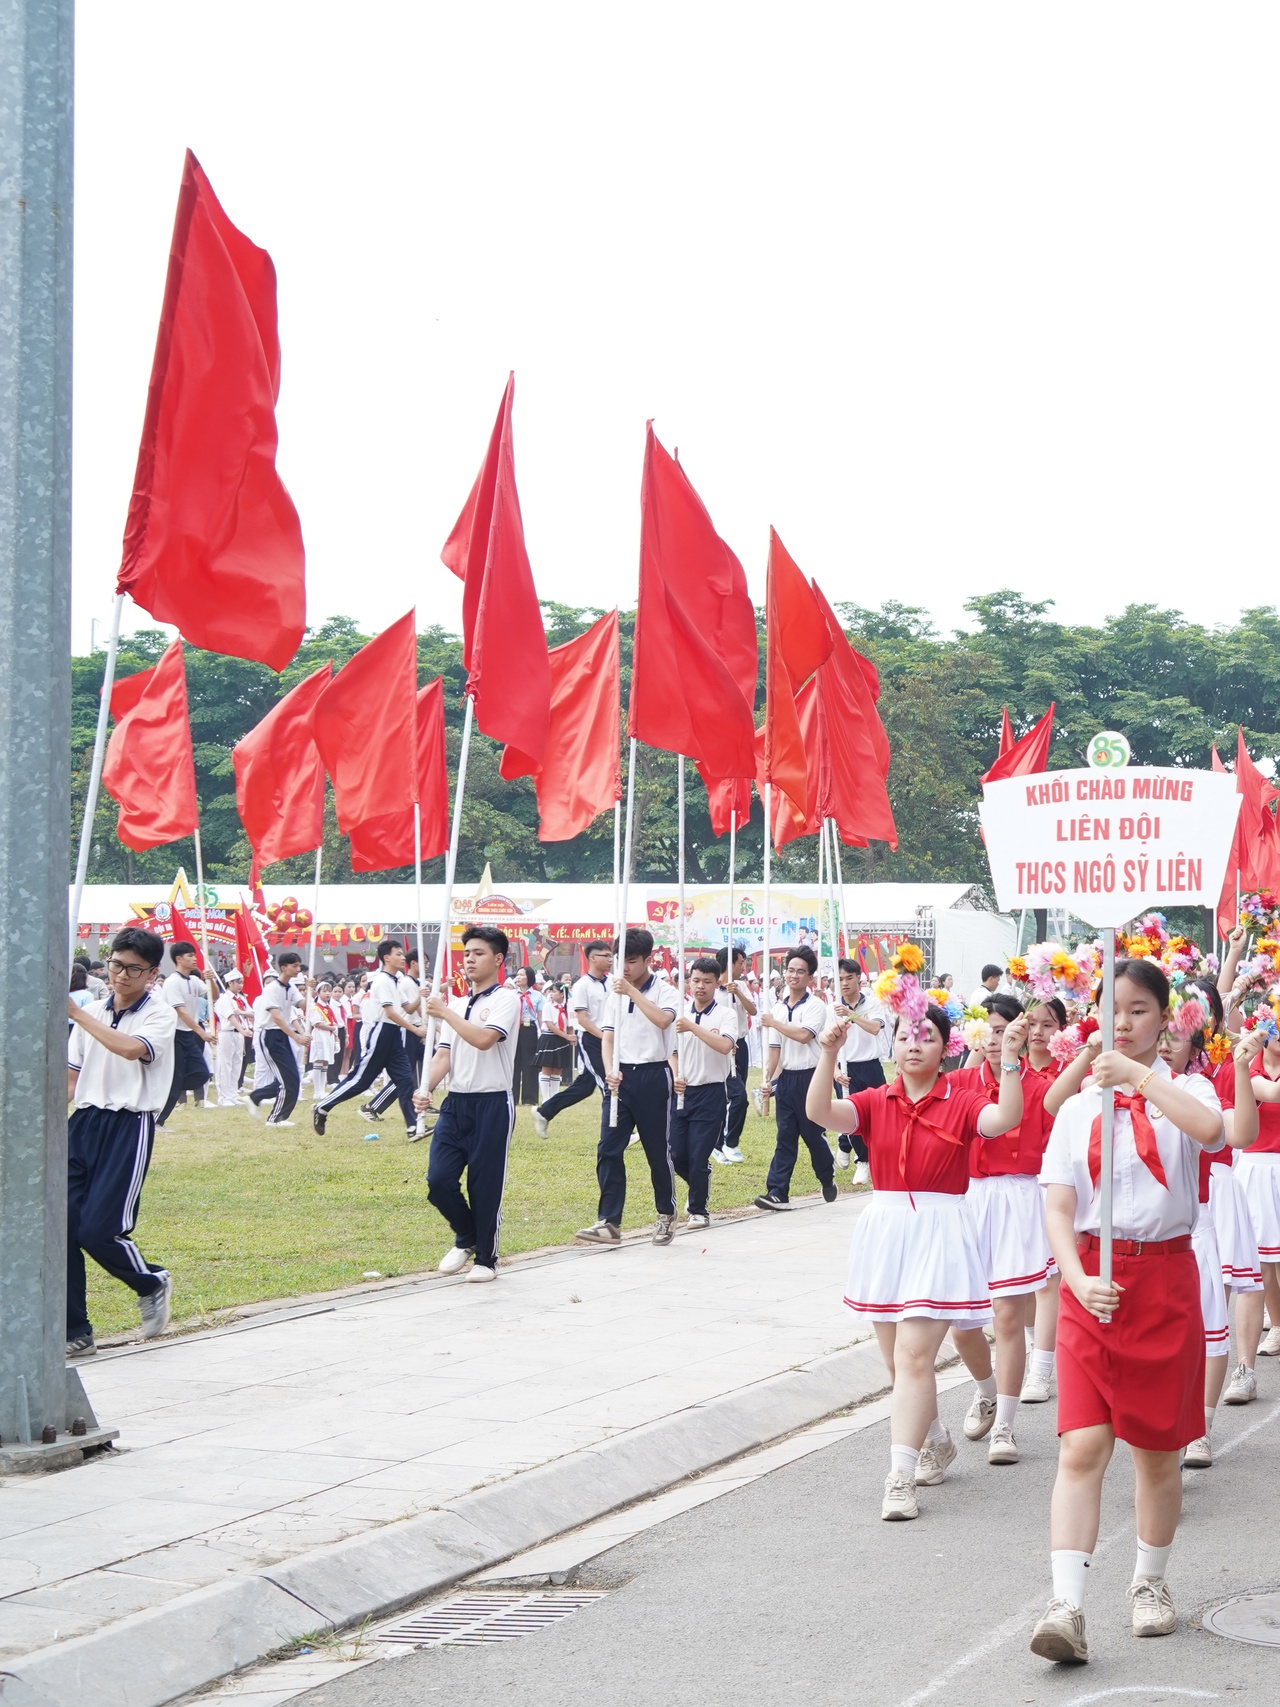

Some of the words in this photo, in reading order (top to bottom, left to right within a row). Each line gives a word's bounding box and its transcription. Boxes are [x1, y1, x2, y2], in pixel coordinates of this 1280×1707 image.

[1092, 736, 1127, 768] 85
[1025, 775, 1070, 806] KHỐI
[1076, 775, 1126, 801] CHÀO
[1132, 775, 1194, 802] MỪNG
[1056, 813, 1111, 841] LIÊN
[1119, 812, 1161, 845] ĐỘI
[1015, 861, 1066, 895] THCS
[1074, 853, 1116, 893] NGÔ
[1123, 853, 1150, 893] SỸ
[1156, 851, 1203, 892] LIÊN
